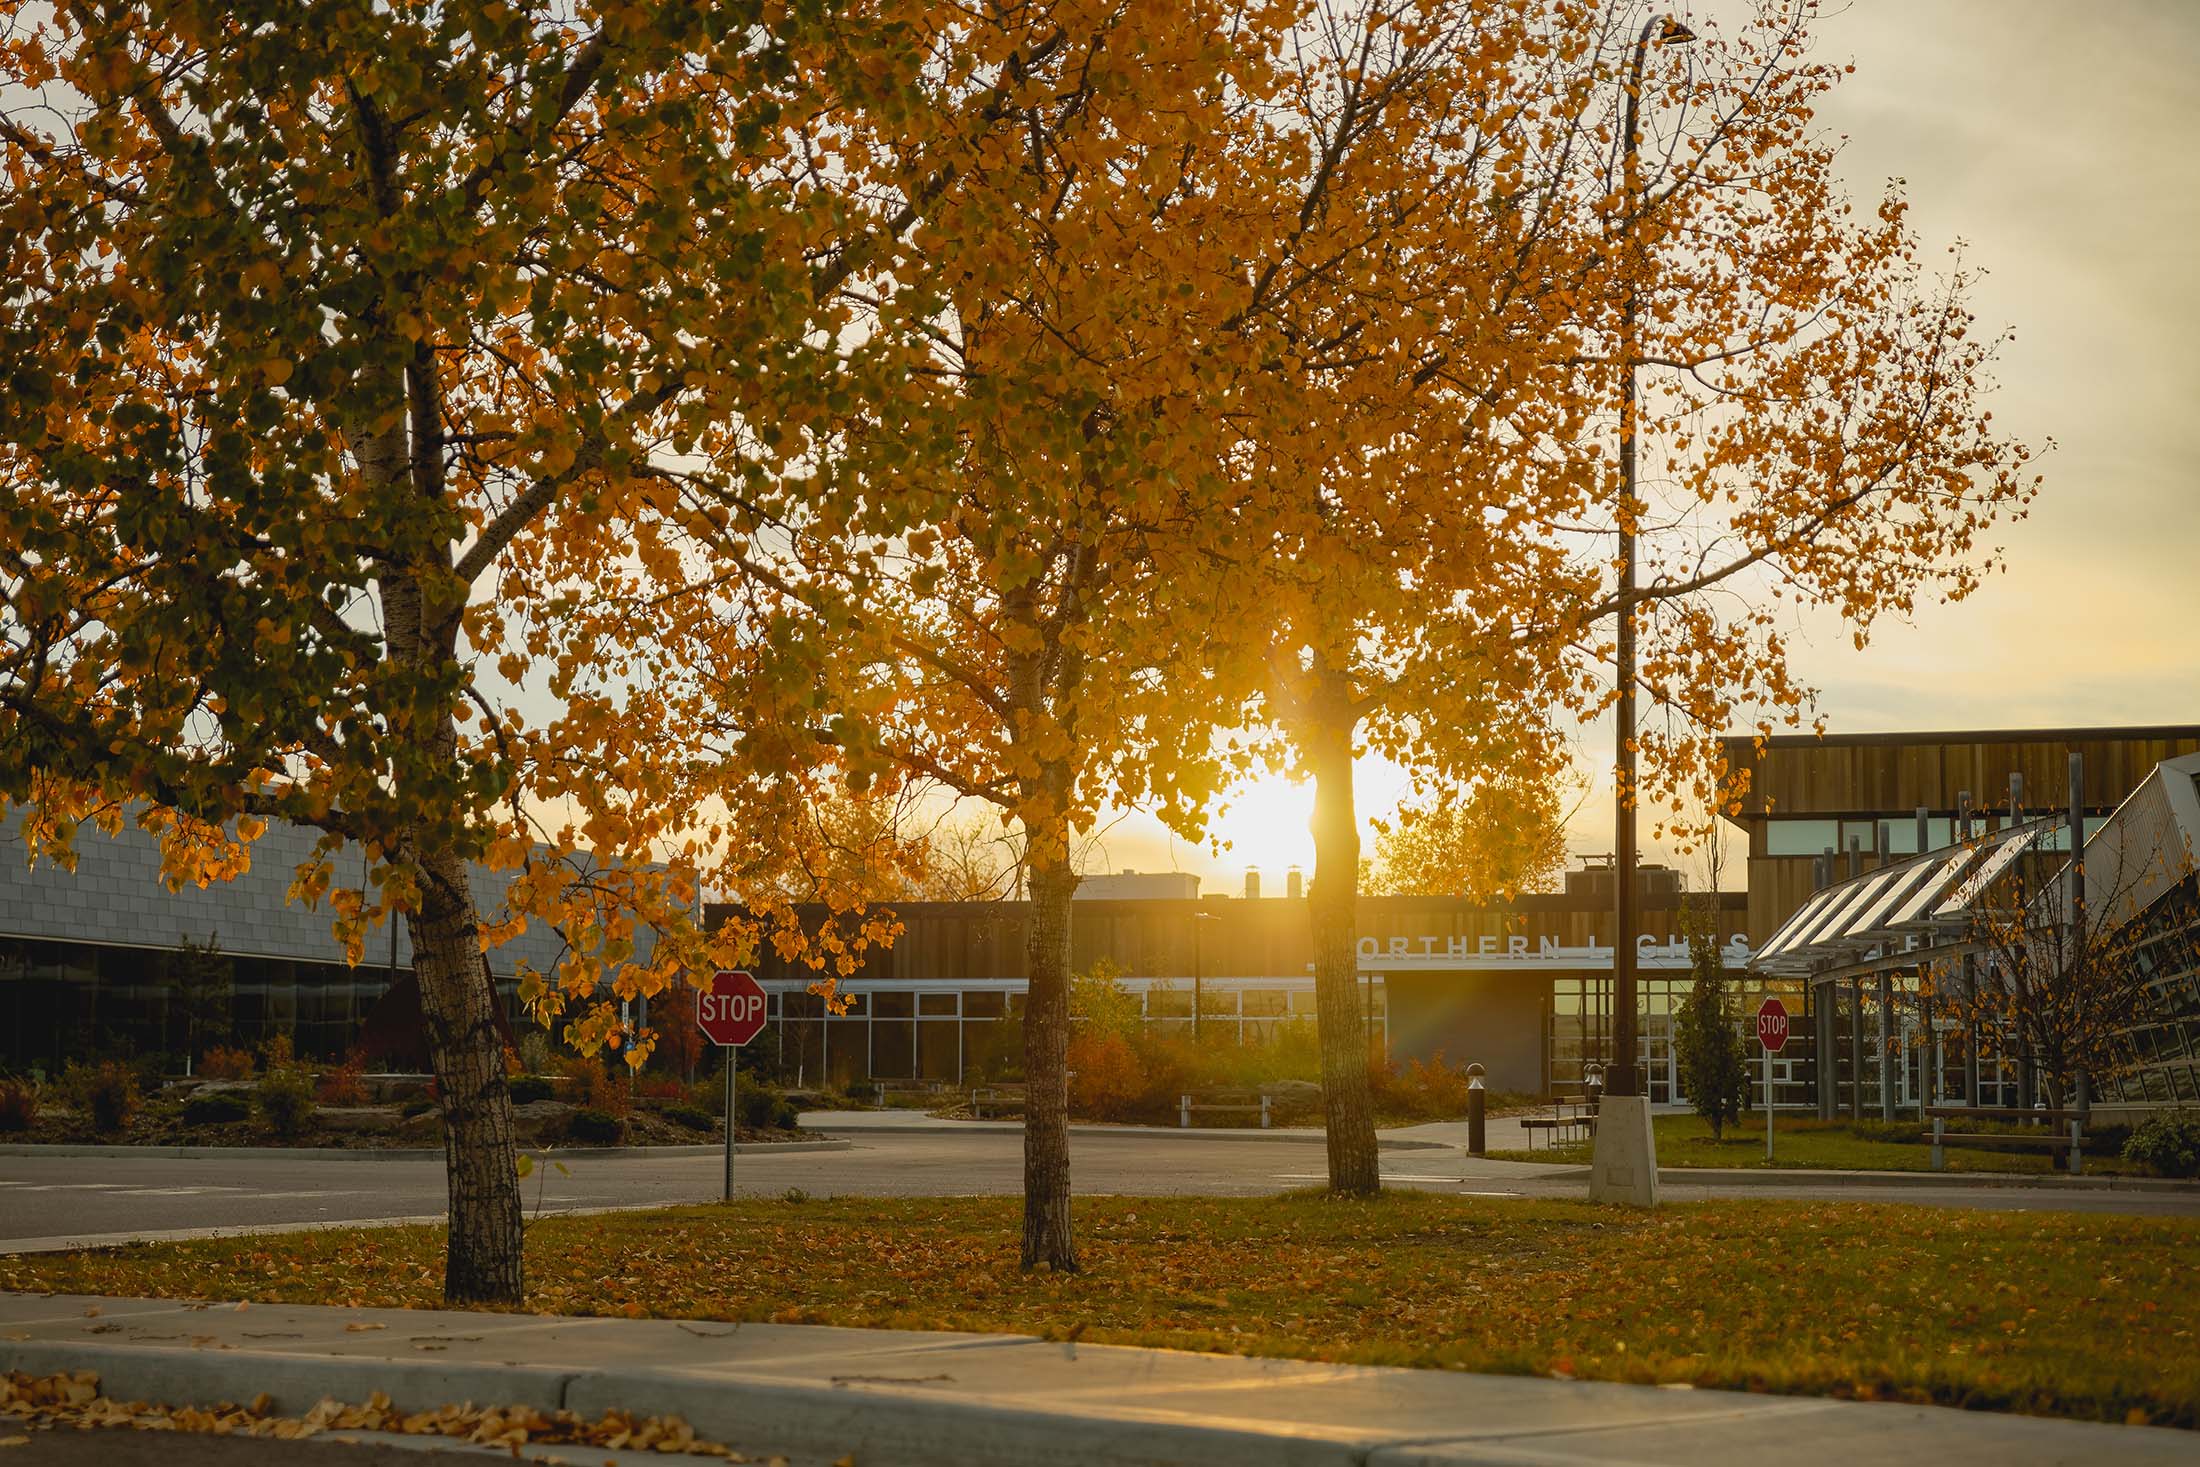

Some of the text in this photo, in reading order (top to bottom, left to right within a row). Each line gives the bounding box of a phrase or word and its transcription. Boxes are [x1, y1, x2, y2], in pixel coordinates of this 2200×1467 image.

[1356, 934, 1749, 960] ORTHERN LGHS
[702, 995, 762, 1022] STOP
[1760, 1015, 1786, 1034] STOP
